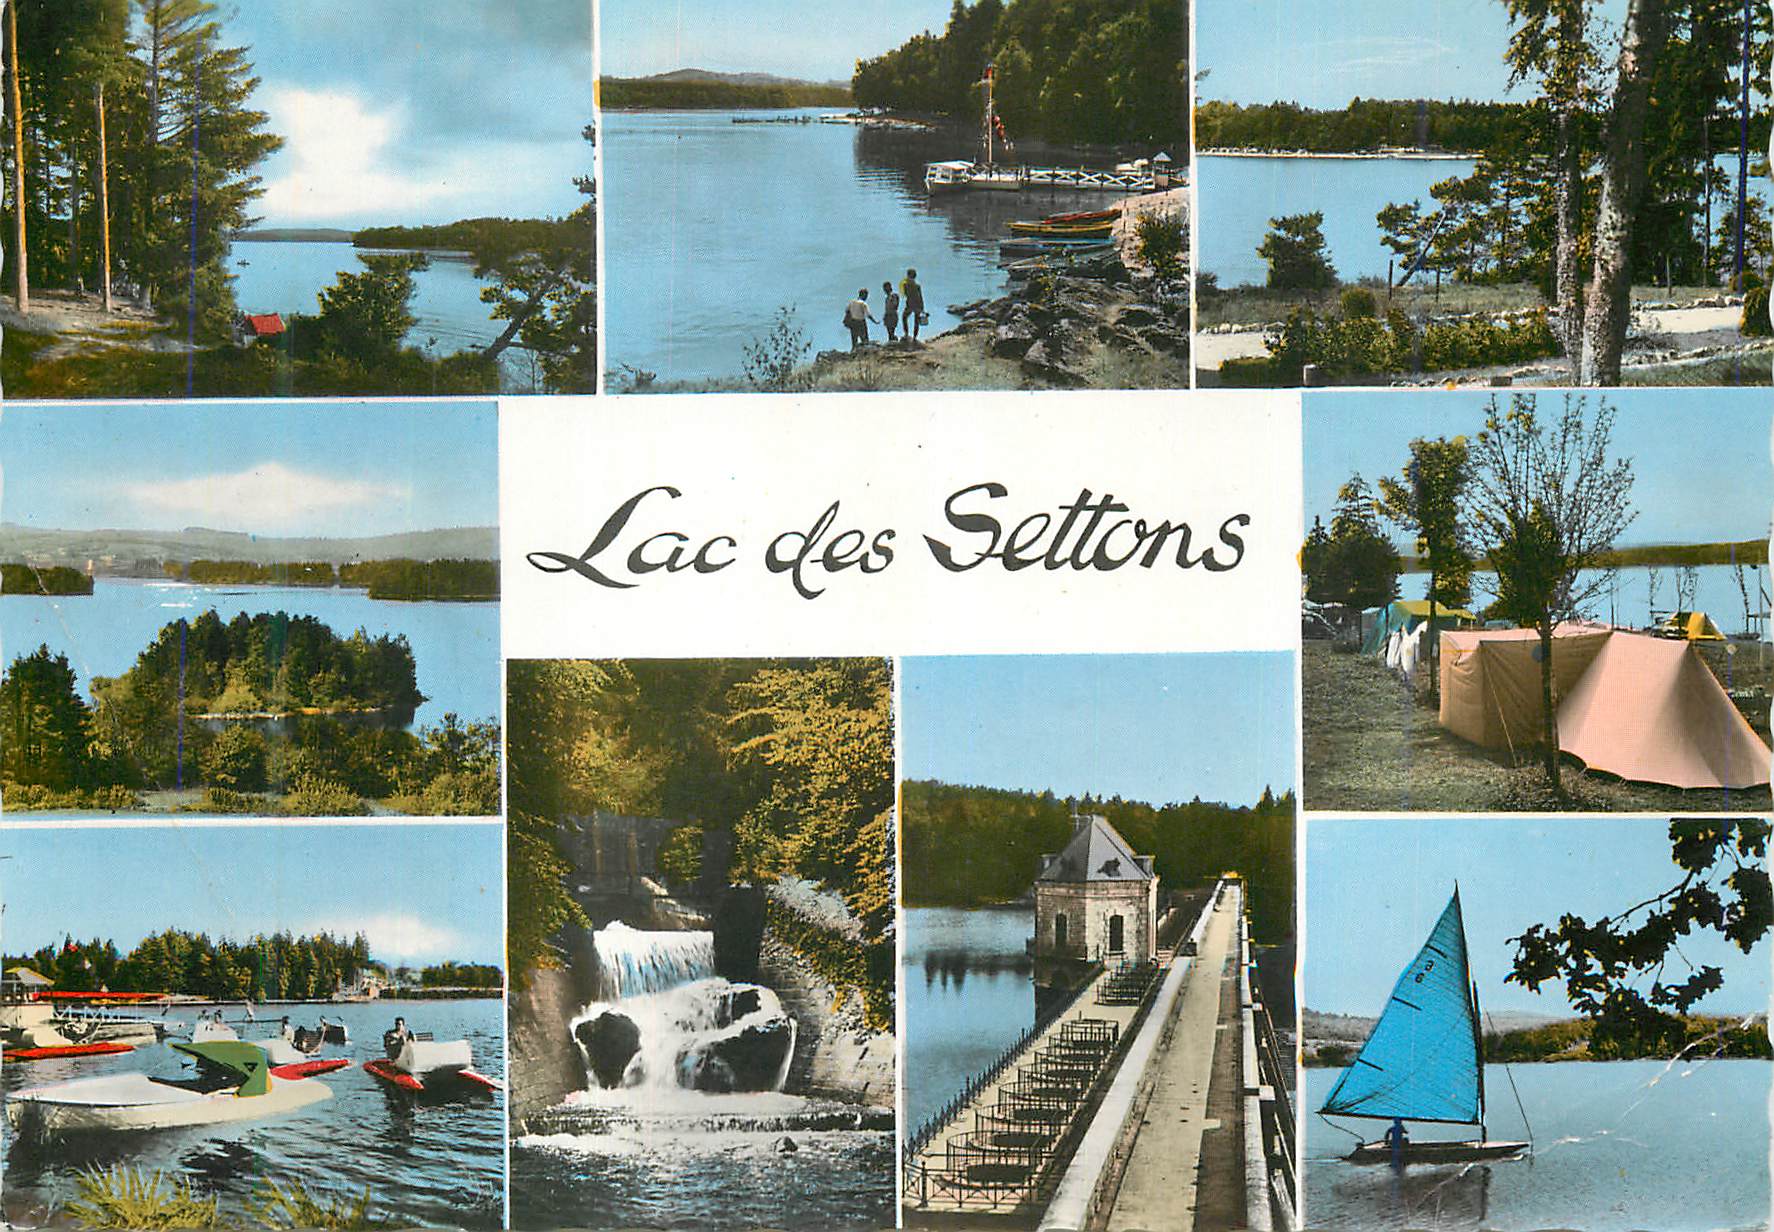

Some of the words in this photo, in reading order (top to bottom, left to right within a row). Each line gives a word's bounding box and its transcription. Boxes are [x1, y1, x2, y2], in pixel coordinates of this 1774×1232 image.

[527, 486, 737, 589] Lac
[765, 500, 896, 600] des
[922, 482, 1251, 573] Settons
